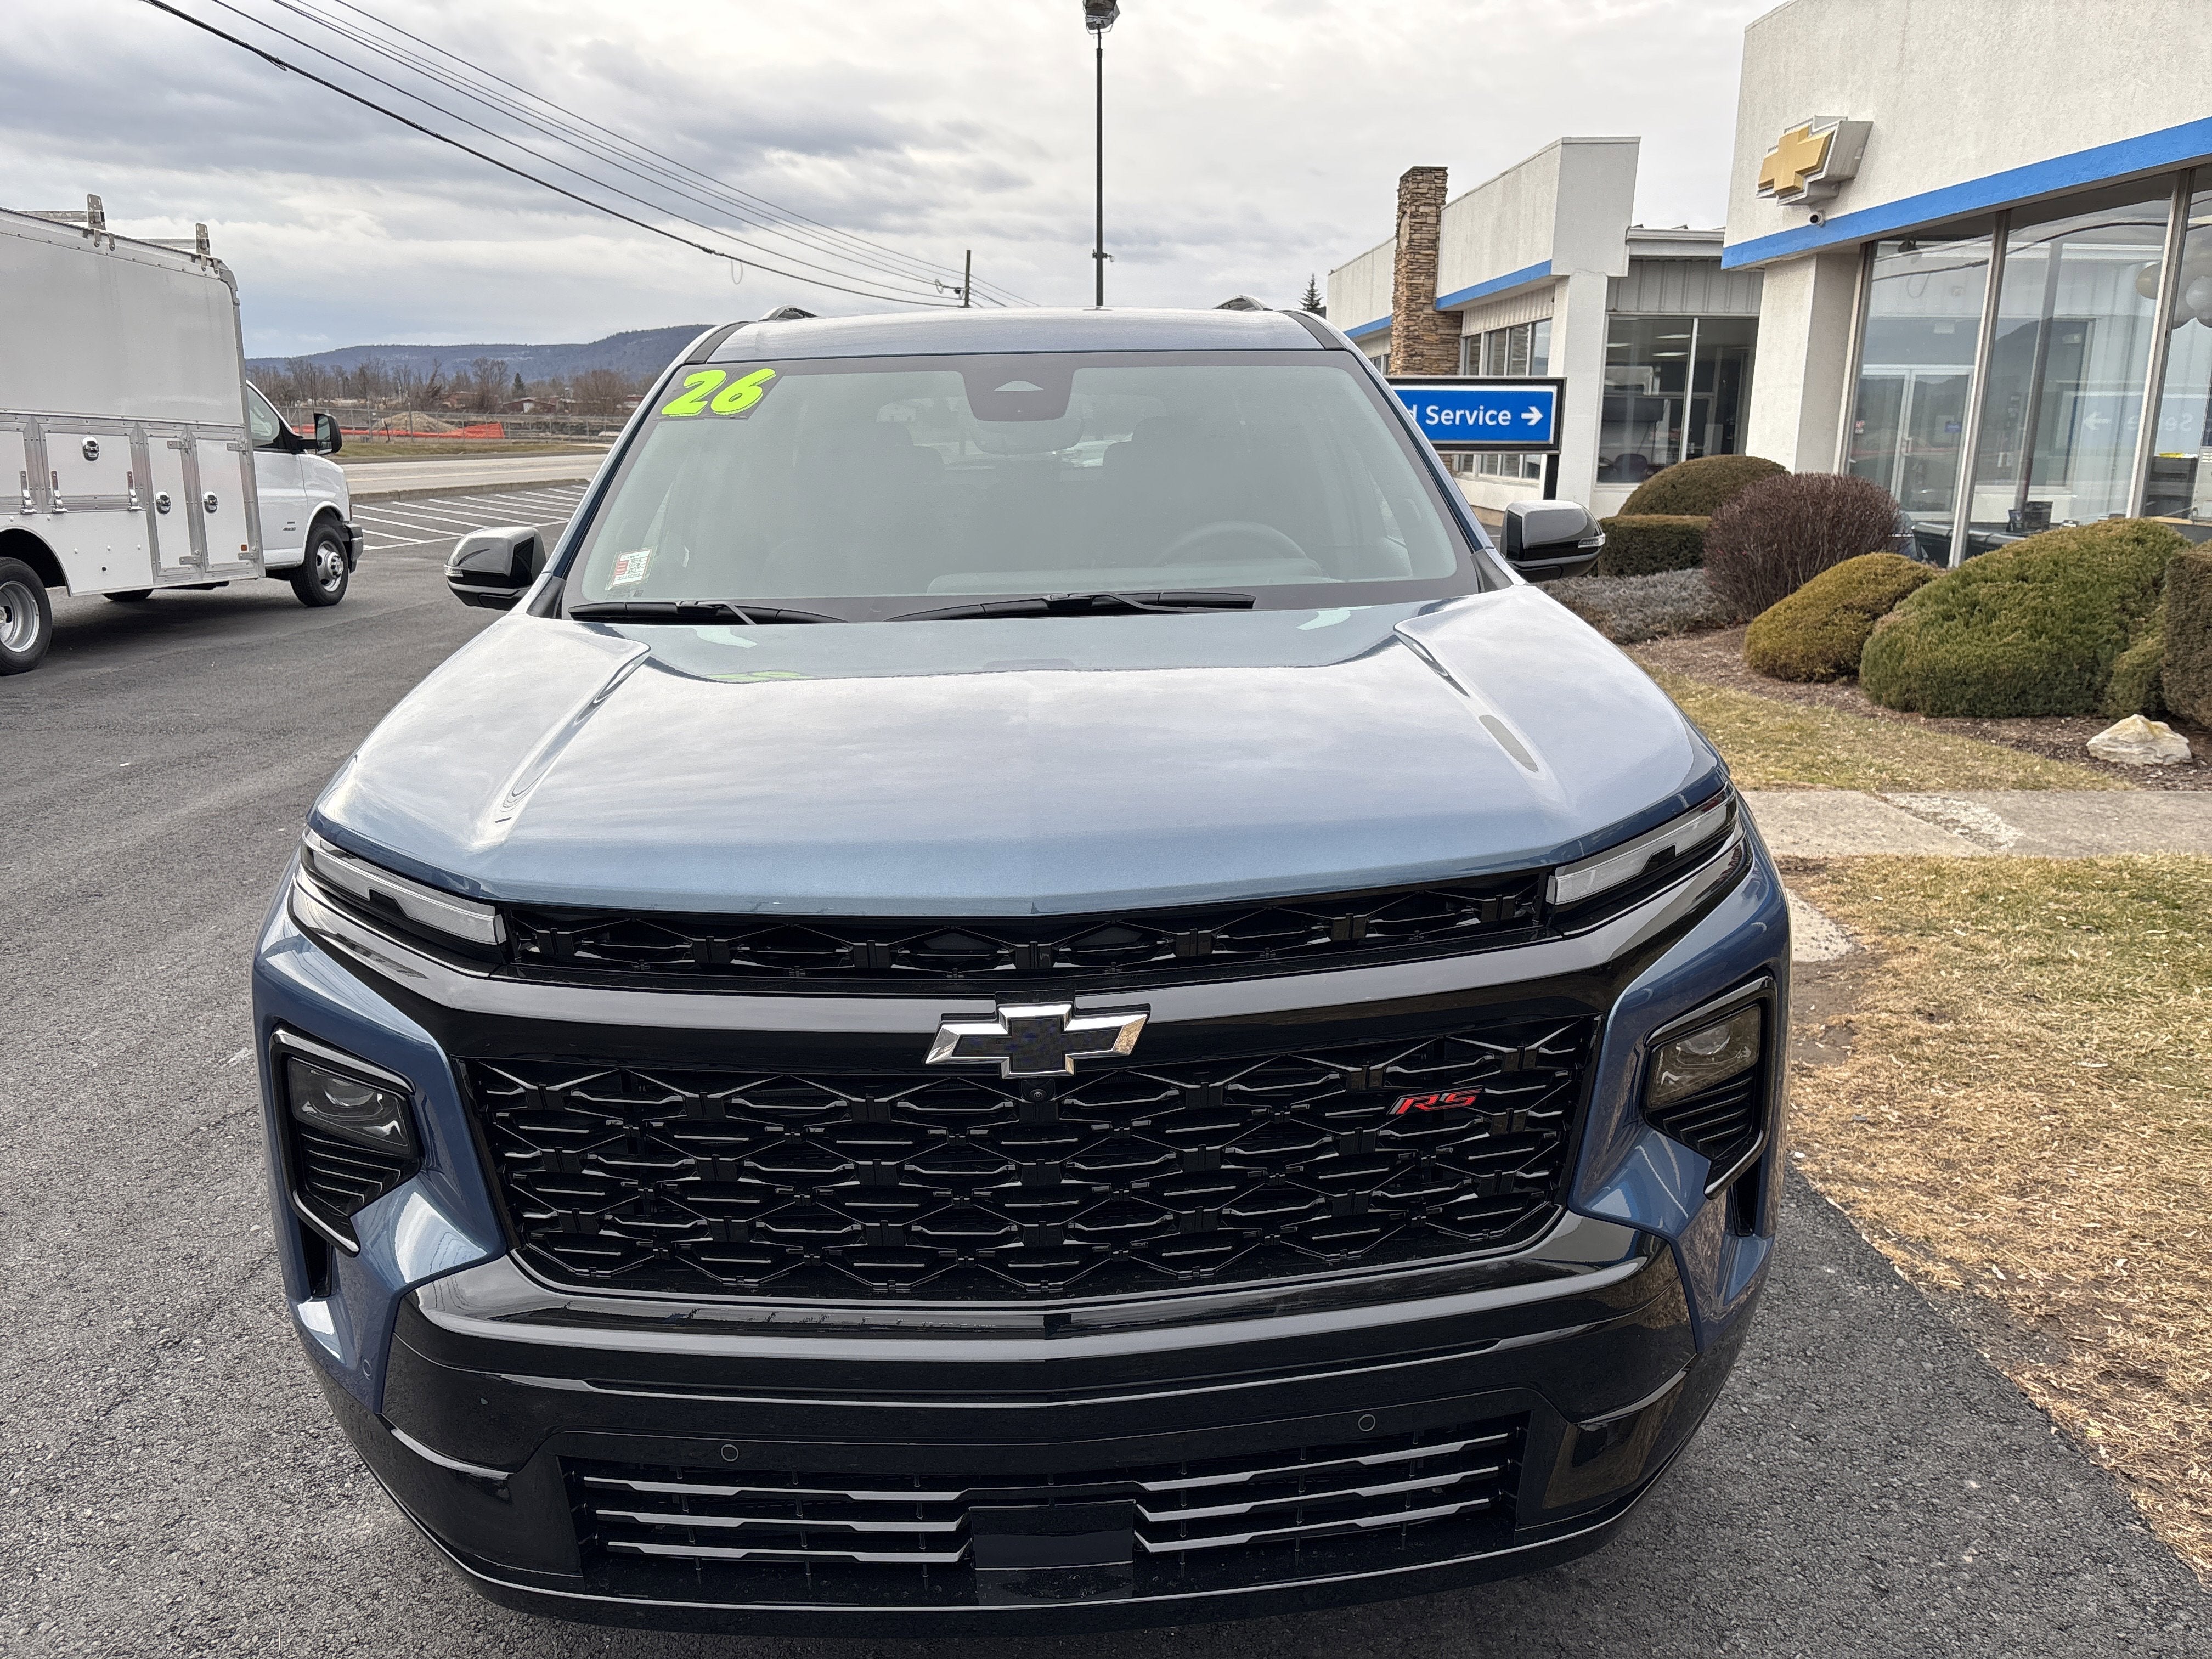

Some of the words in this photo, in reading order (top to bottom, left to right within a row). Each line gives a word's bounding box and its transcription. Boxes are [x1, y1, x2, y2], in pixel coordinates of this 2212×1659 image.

[661, 368, 776, 417] 26
[1425, 405, 1511, 426] Service
[1387, 1088, 1482, 1115] RS
